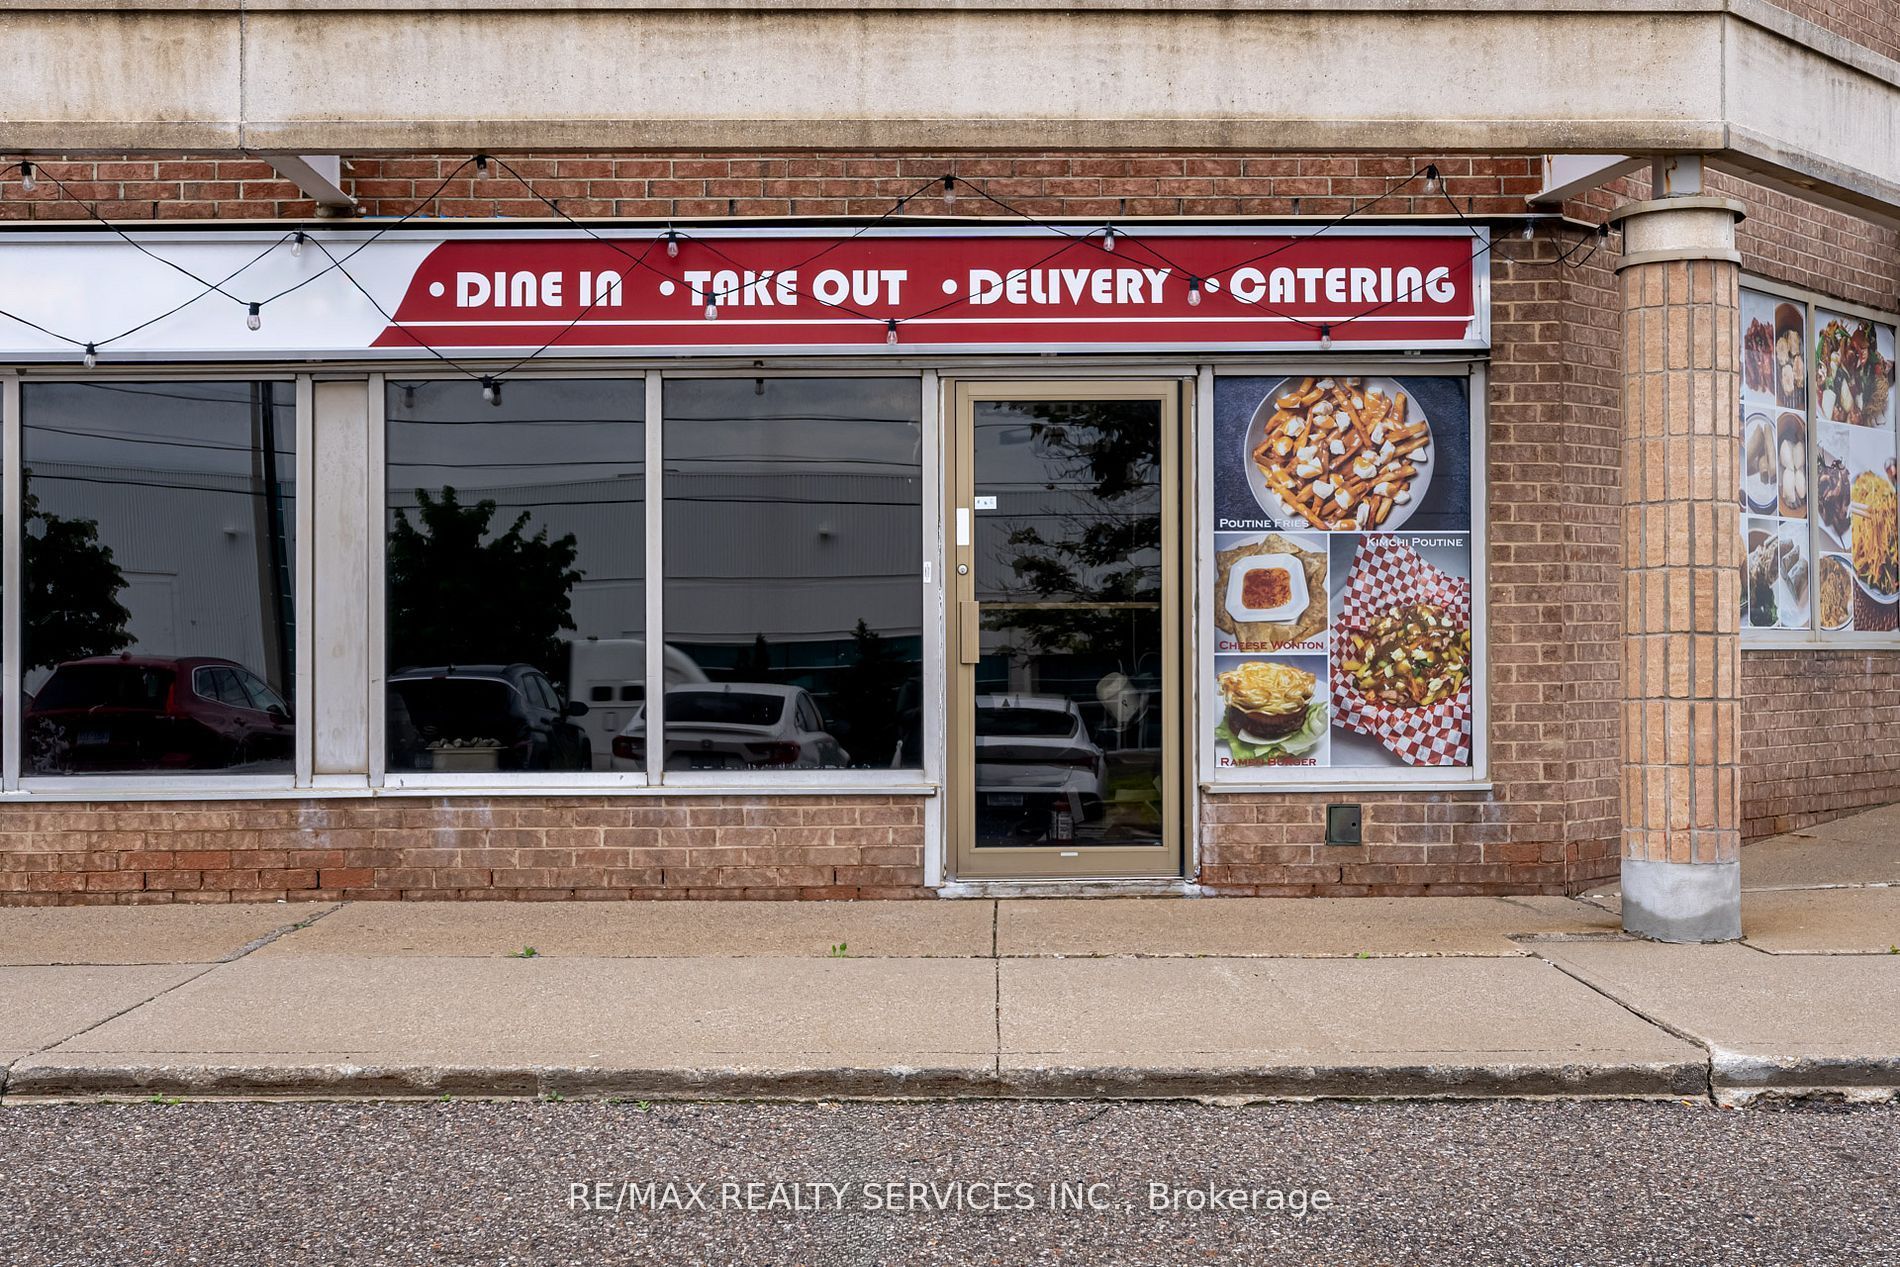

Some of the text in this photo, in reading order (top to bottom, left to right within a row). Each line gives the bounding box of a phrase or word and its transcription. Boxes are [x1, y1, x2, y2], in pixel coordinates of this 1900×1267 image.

[456, 267, 1456, 307] DINE IN TAKE OUT DELIVERY CATERING
[1219, 518, 1310, 528] POUTINE FRIES
[1366, 537, 1464, 547] KIMCHI POUTINE
[1219, 640, 1324, 650] CHEESE WONTON
